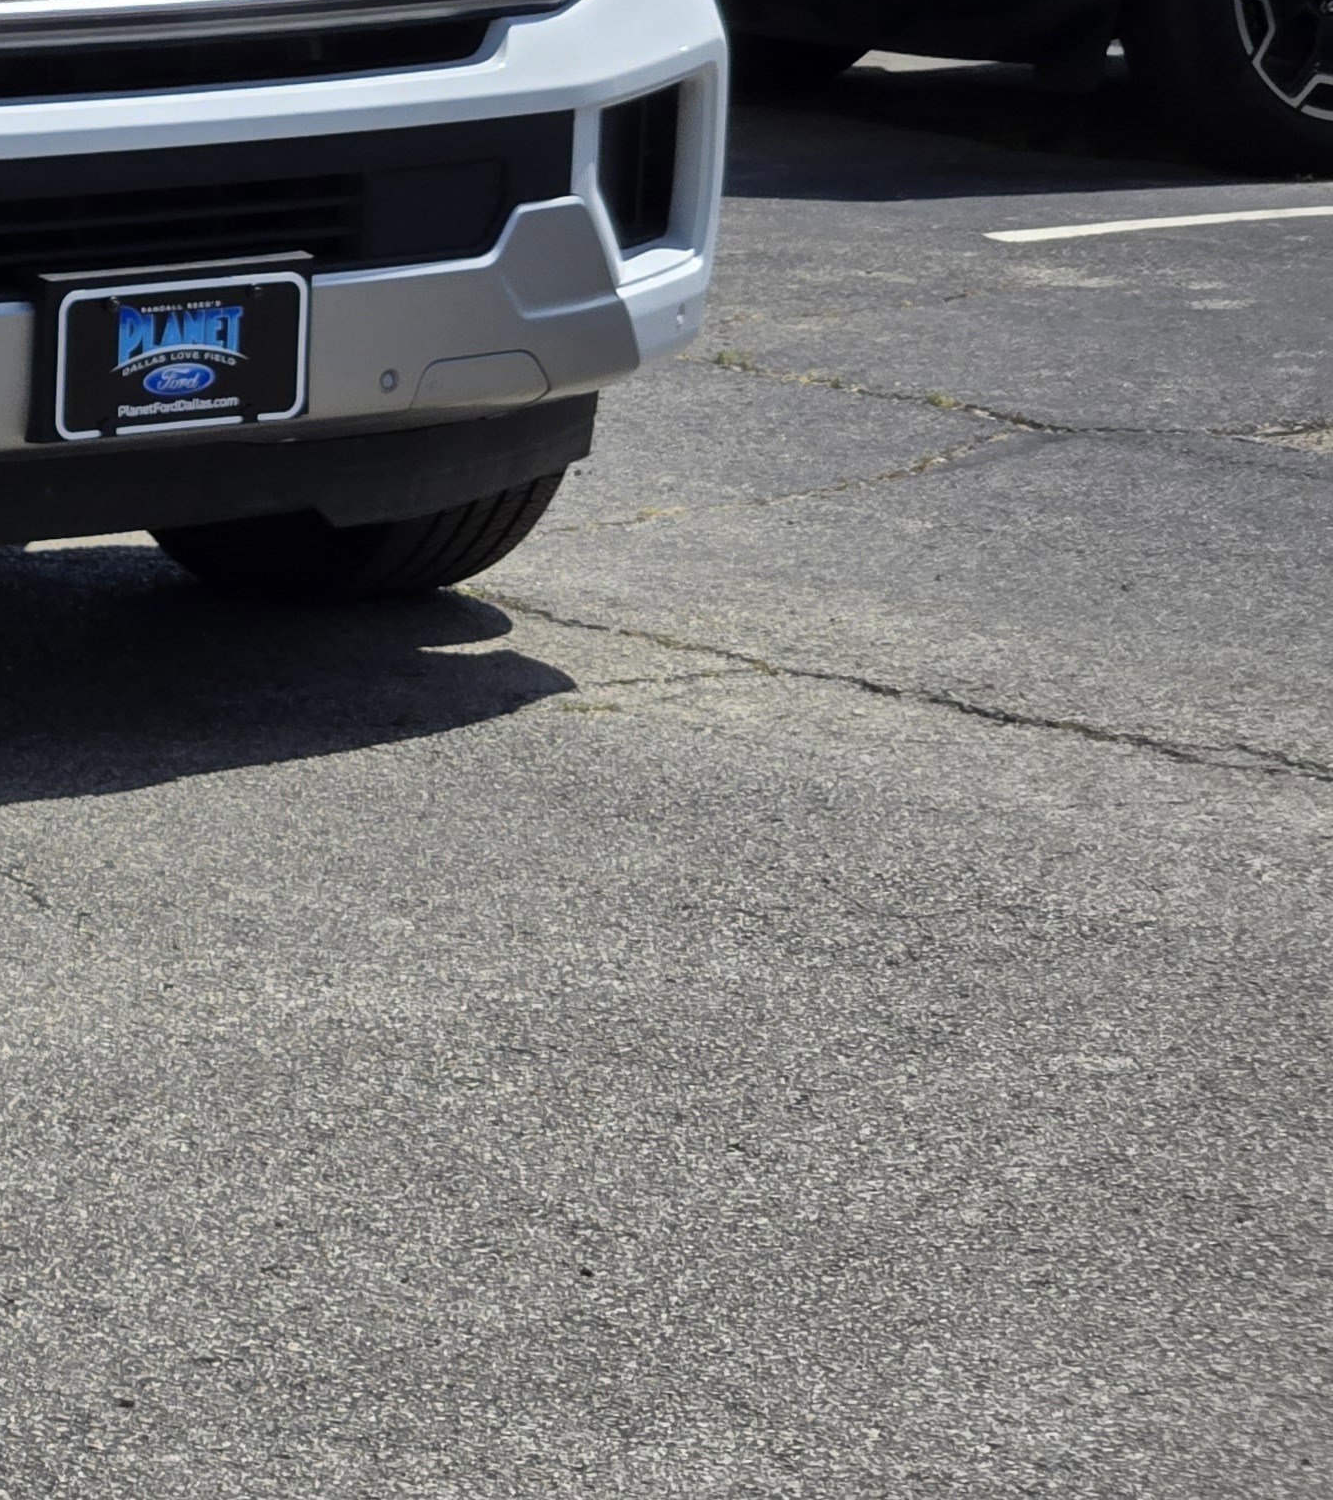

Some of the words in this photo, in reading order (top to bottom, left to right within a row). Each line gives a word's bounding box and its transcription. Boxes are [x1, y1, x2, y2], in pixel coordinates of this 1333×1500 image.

[117, 304, 244, 367] PLANET
[121, 354, 166, 377] DALLAS
[170, 350, 200, 361] LOVE
[203, 351, 237, 366] FIELD
[156, 367, 200, 390] Ford
[117, 396, 240, 418] PlanetFordDallas.com
